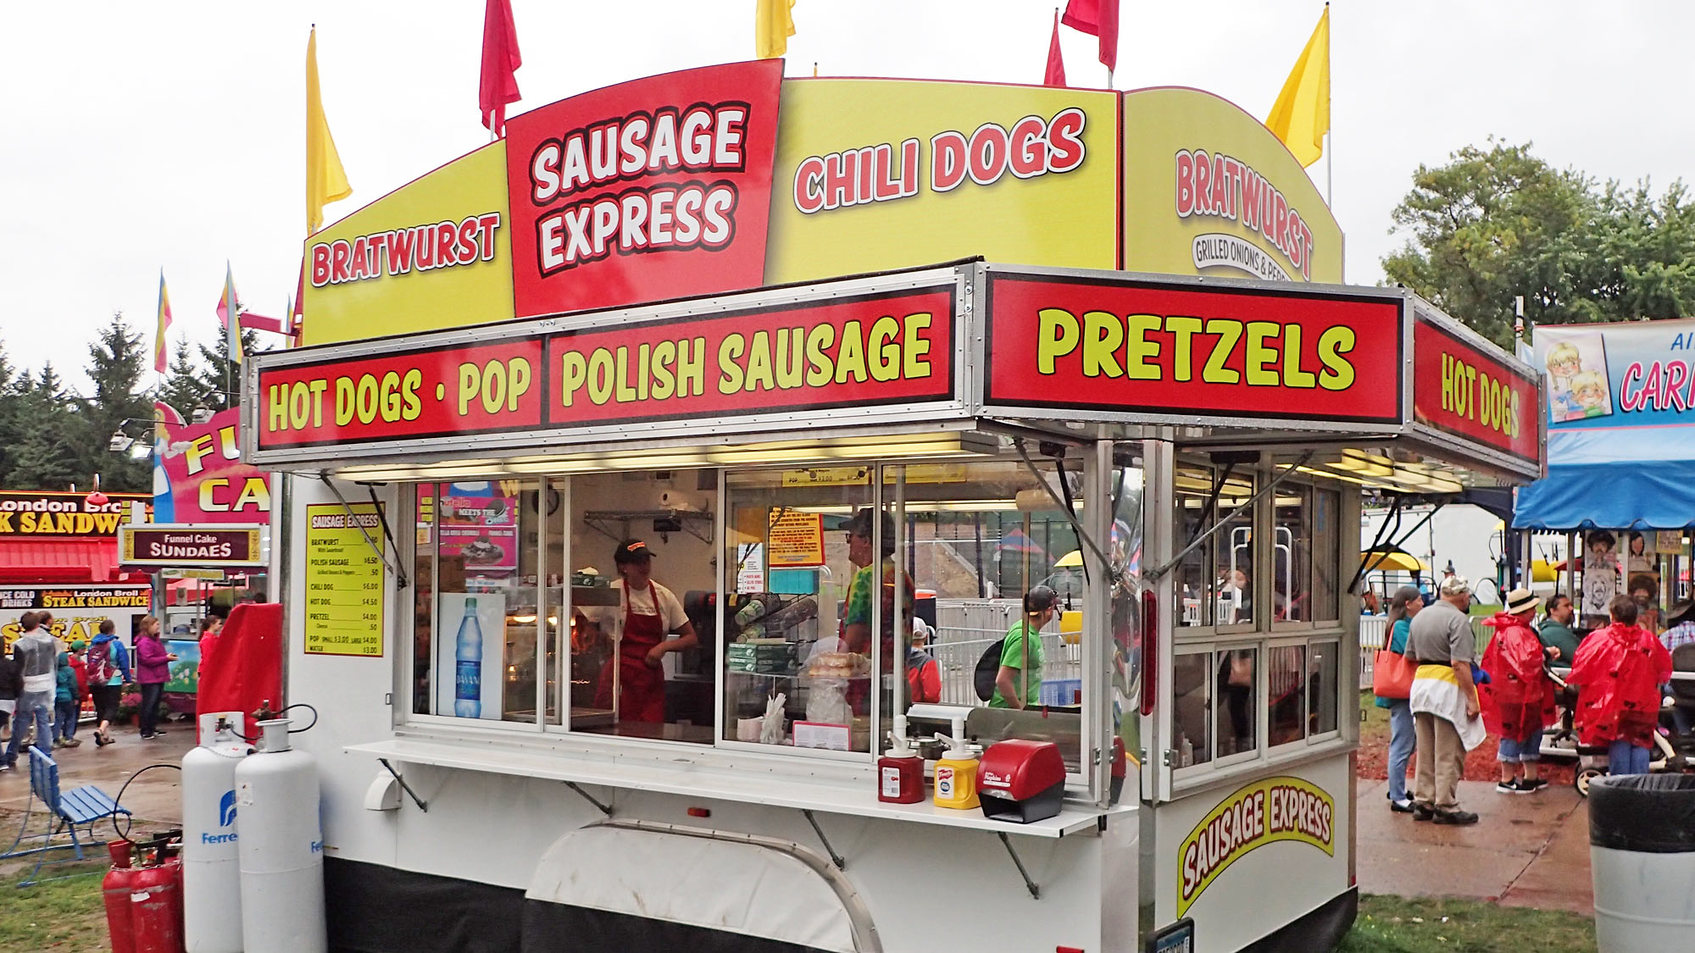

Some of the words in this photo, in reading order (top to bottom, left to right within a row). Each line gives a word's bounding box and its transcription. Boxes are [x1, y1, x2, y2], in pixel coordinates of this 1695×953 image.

[531, 106, 749, 205] SAUSAGE
[794, 137, 920, 214] CHILI
[930, 107, 1087, 194] DOGS
[538, 182, 737, 277] EXPRESS
[1176, 149, 1314, 282] BRATWURST
[311, 212, 500, 287] BRATWURST
[1195, 239, 1229, 262] GRILLED
[1230, 241, 1260, 271] ONIONS
[1260, 256, 1267, 276] &
[561, 337, 706, 408] POLISH
[717, 312, 933, 396] SAUSAGE
[1037, 307, 1356, 392] PRETZELS
[269, 379, 327, 432] HOT
[335, 368, 422, 427] DOGS
[458, 357, 532, 416] POP
[1441, 352, 1476, 420] HOT
[1480, 372, 1520, 440] DOGS
[150, 542, 232, 557] SUNDAES
[164, 534, 193, 543] Funnel
[194, 534, 218, 543] Cake
[311, 538, 339, 546] BRATWURST
[312, 514, 345, 529] SAUSAGE
[2, 599, 33, 607] DRINKS
[14, 591, 35, 599] COLD
[43, 596, 86, 608] STEAK
[320, 598, 331, 606] DOG
[362, 598, 377, 606] $4.50
[362, 613, 377, 621] $4.00
[1183, 790, 1265, 901] SAUSAGE
[1270, 785, 1332, 844] EXPRESS
